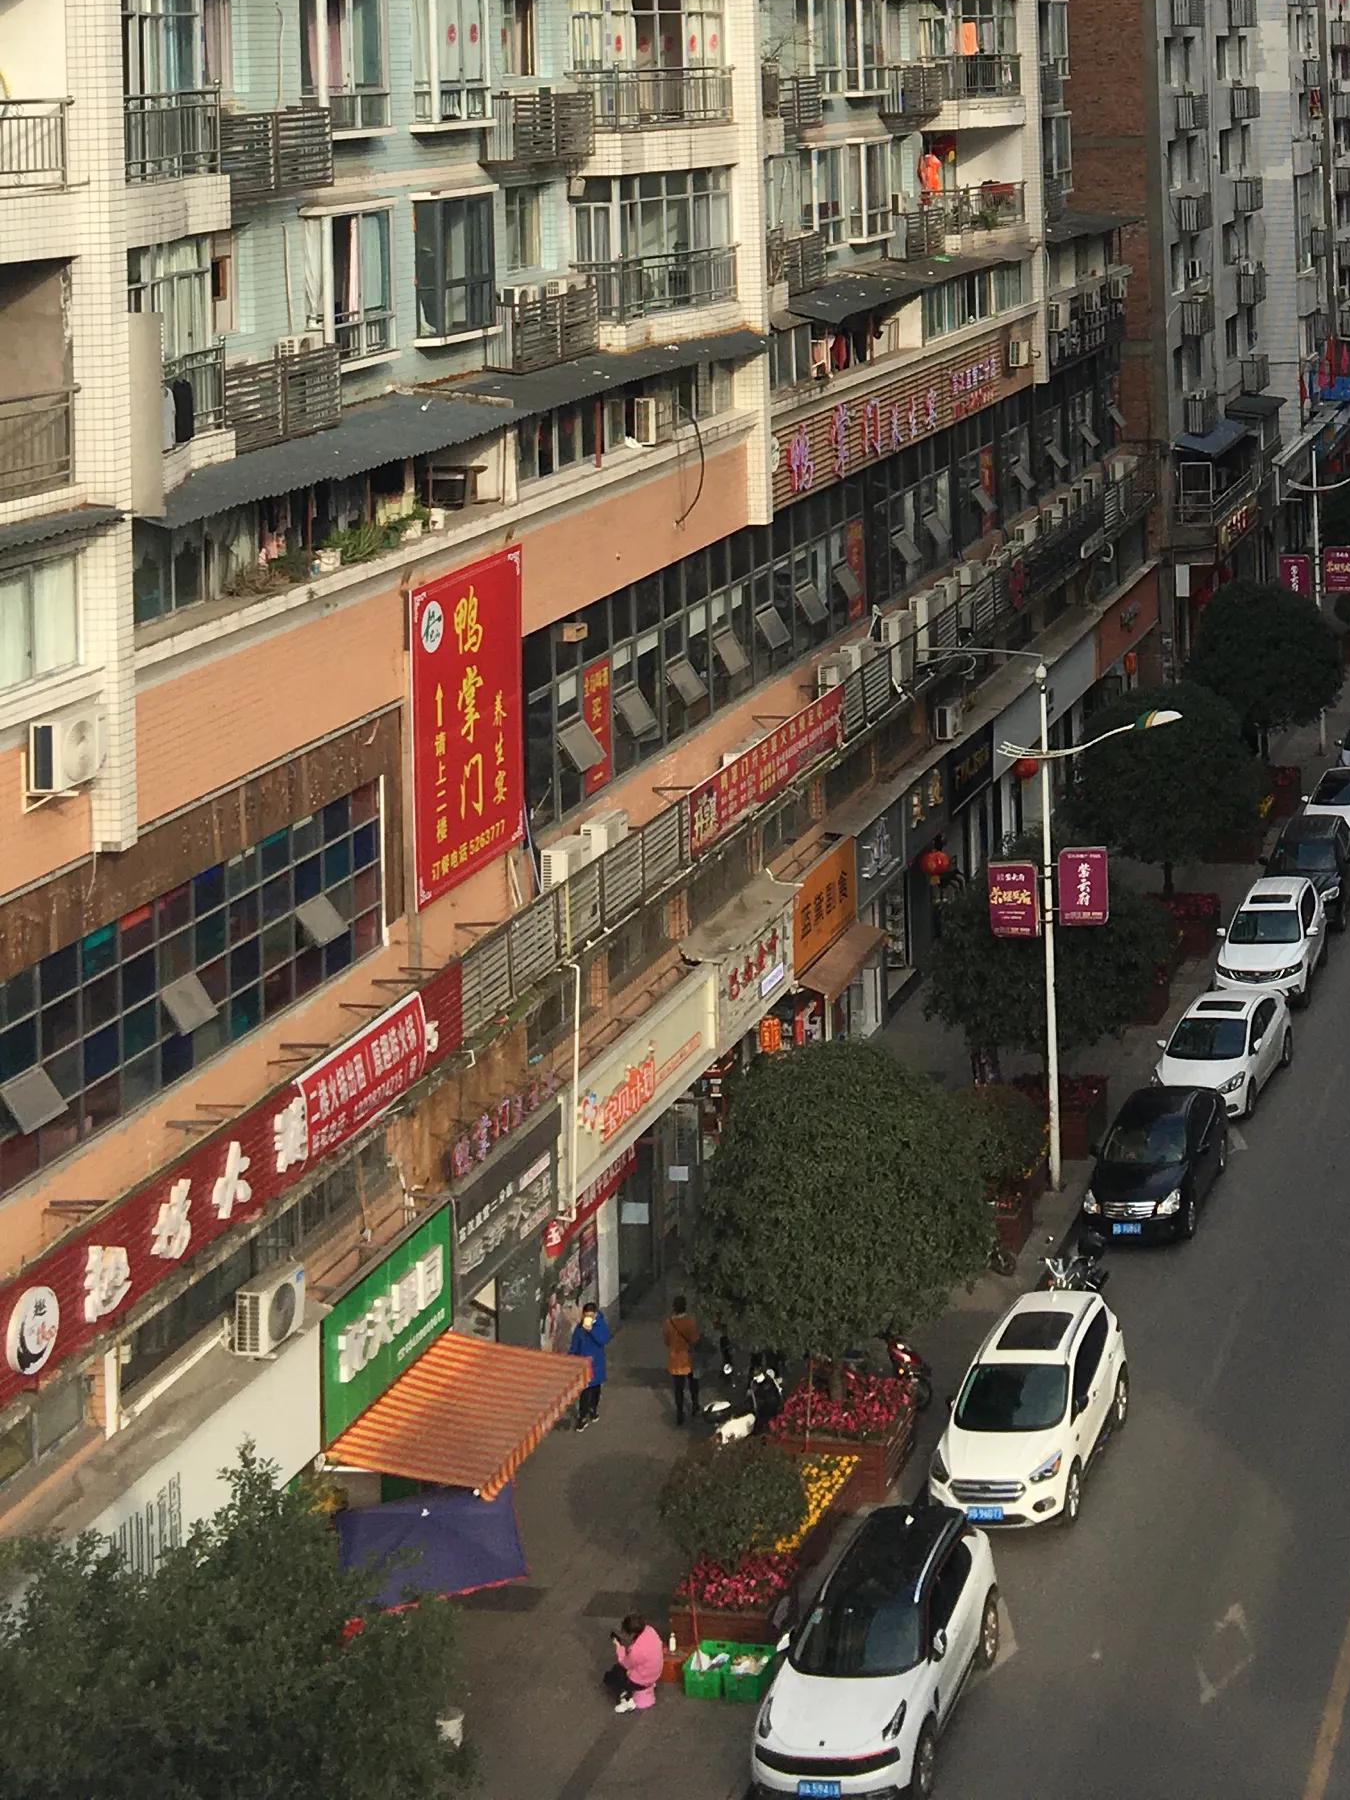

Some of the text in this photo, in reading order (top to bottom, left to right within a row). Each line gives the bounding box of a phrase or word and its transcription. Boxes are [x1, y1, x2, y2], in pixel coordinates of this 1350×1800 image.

[454, 584, 484, 820] 鸭掌门
[493, 690, 507, 805] 养生宴
[434, 730, 448, 844] 请上二楼
[431, 818, 506, 882] 订餐电话 5263777
[603, 1059, 655, 1141] 宝贝计划
